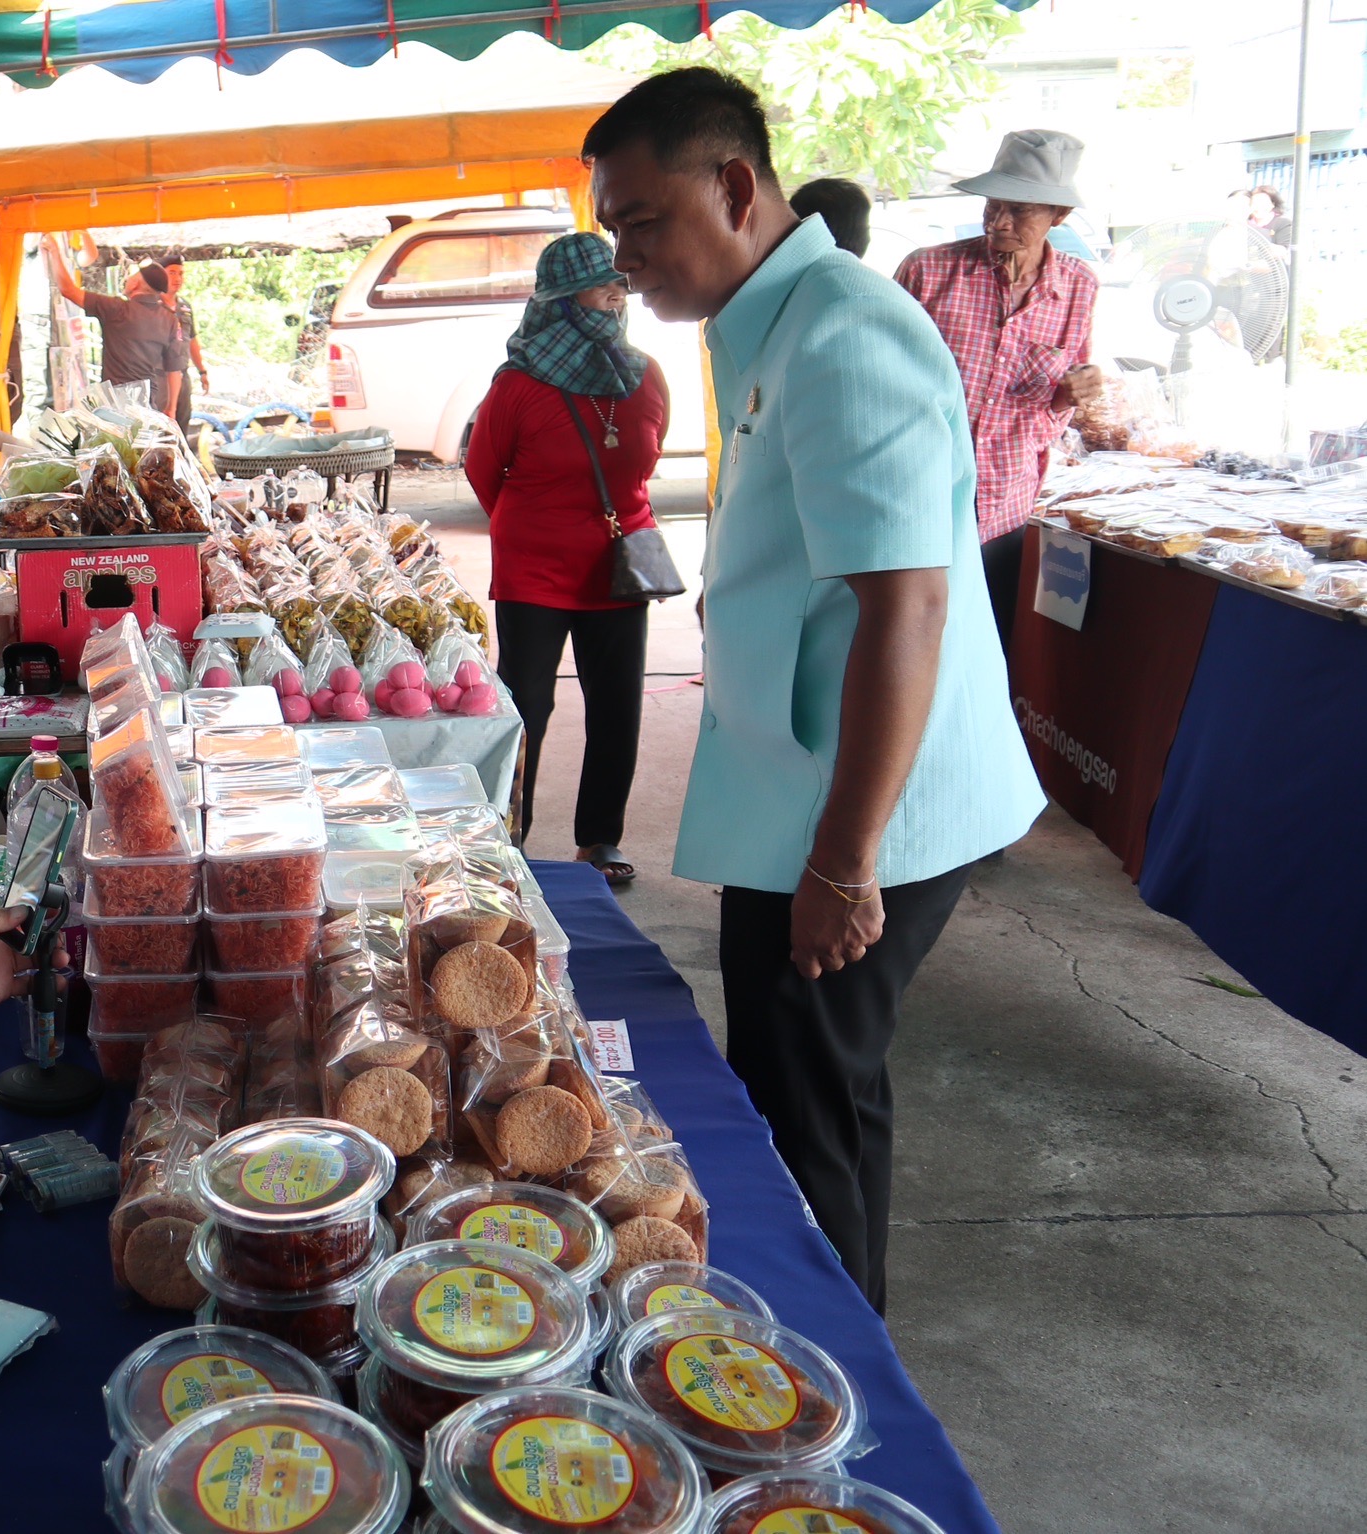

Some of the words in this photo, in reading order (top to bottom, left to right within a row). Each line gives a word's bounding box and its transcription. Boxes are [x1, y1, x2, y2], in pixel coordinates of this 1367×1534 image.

[70, 556, 97, 567] NEW
[98, 553, 150, 566] ZEALAND
[1013, 696, 1118, 796] Chachoengsao
